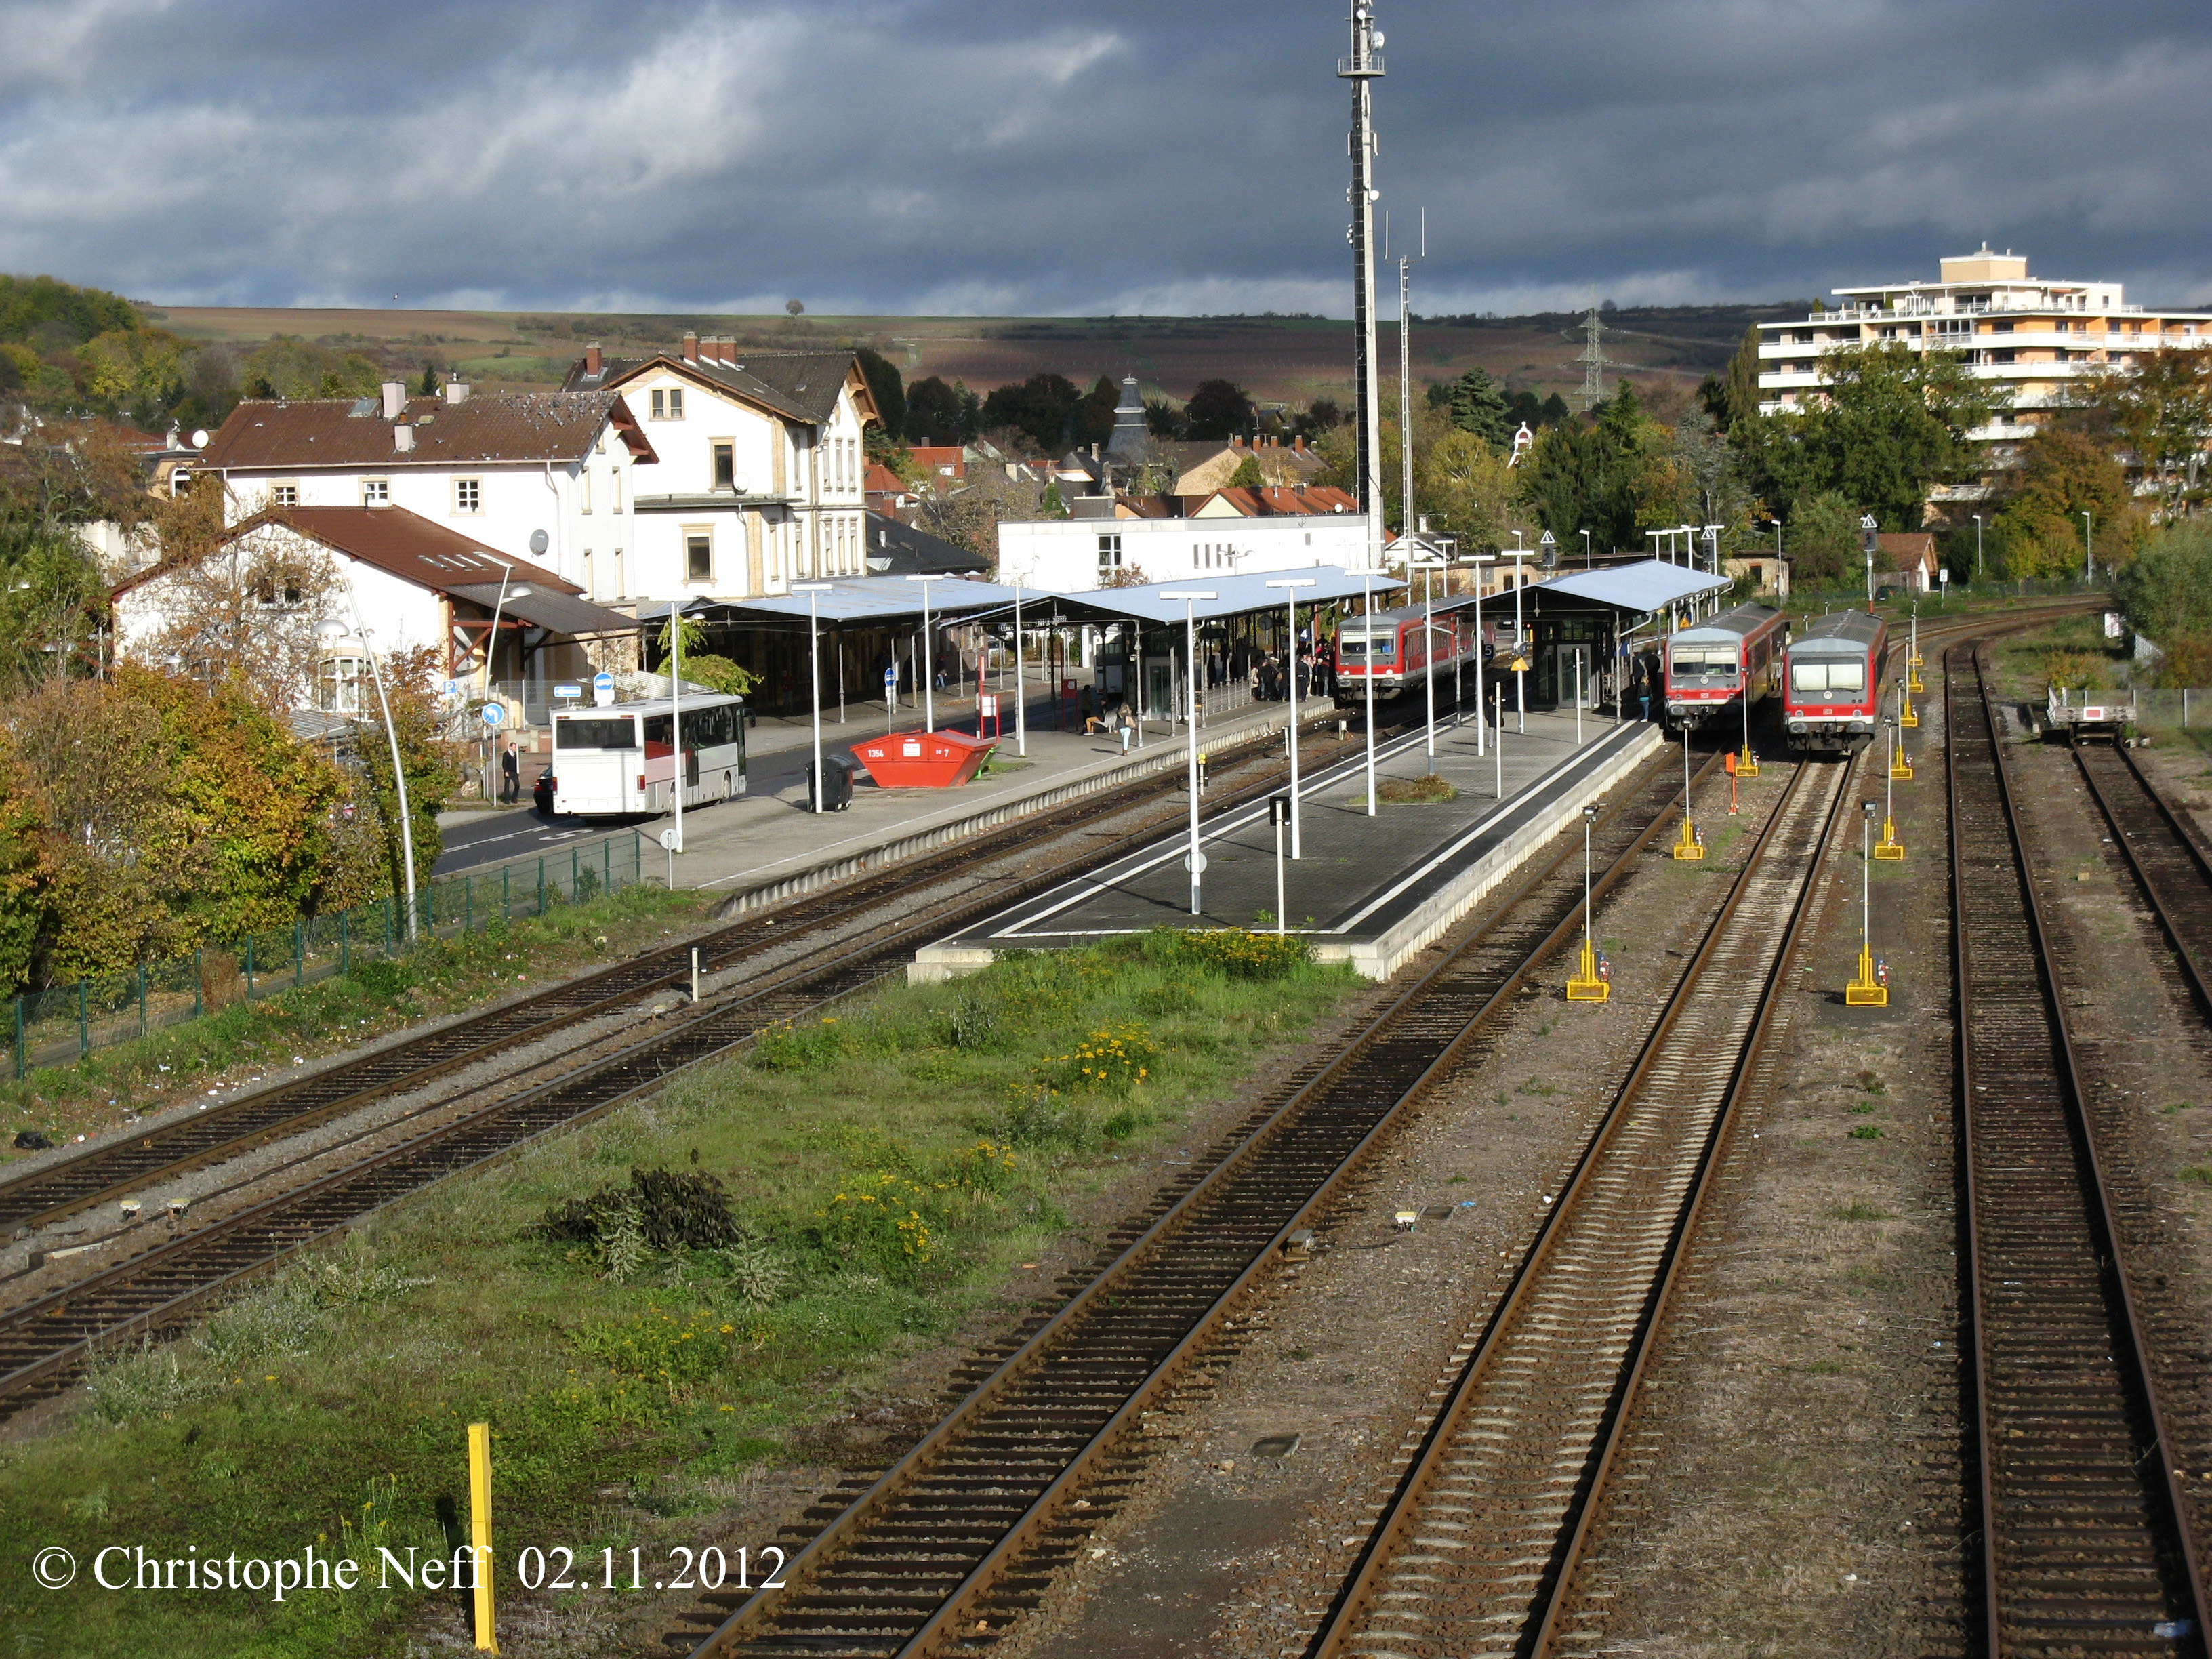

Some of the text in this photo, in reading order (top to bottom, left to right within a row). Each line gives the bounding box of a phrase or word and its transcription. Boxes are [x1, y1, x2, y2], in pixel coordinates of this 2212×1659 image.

[1300, 628, 1308, 639] 4
[1484, 645, 1492, 656] 5
[445, 682, 453, 693] P
[867, 749, 884, 757] 1354
[944, 748, 949, 757] 7
